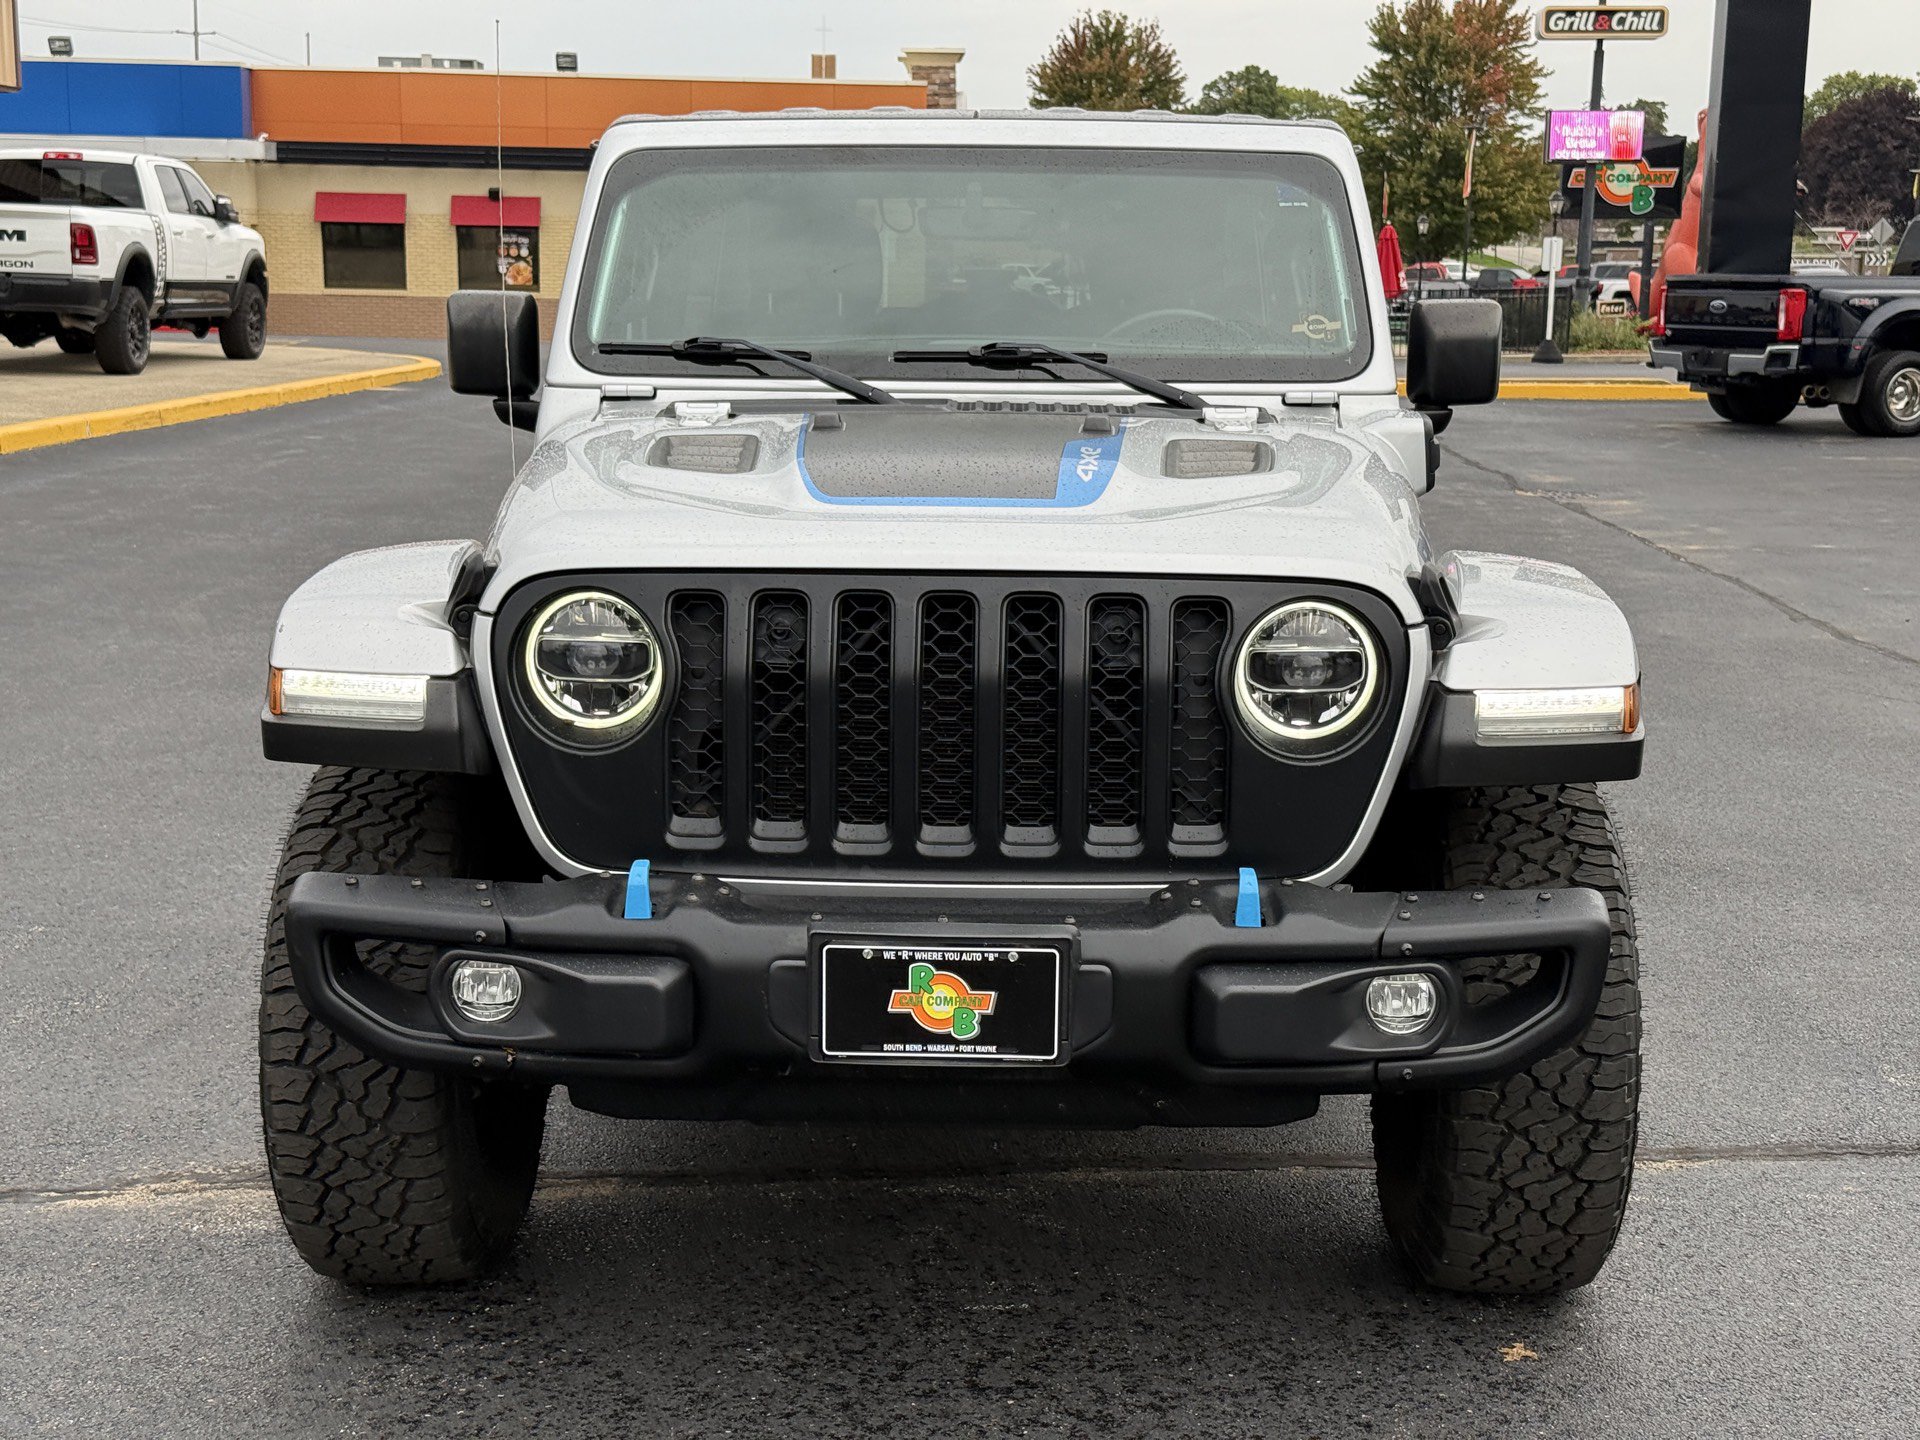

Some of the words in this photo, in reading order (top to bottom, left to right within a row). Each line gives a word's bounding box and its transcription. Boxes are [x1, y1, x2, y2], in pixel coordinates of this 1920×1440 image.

[1575, 173, 1604, 183] CR
[1606, 173, 1673, 183] COMPANY
[1631, 185, 1654, 213] B
[1600, 304, 1624, 313] Enter
[883, 950, 896, 960] WE
[898, 950, 913, 960] "R"
[914, 951, 943, 961] WHERE
[944, 952, 960, 961] YOU
[961, 952, 982, 961] AUTO
[984, 952, 999, 961] "B"
[910, 964, 935, 995] R
[899, 994, 923, 1007] CAR
[926, 995, 985, 1008] COMPANY
[952, 1006, 977, 1037] B
[883, 1043, 904, 1052] SOUTH
[905, 1044, 922, 1052] BEND
[927, 1044, 956, 1053] WARSAW
[959, 1045, 975, 1053] FORT
[975, 1045, 998, 1053] WAYNE
